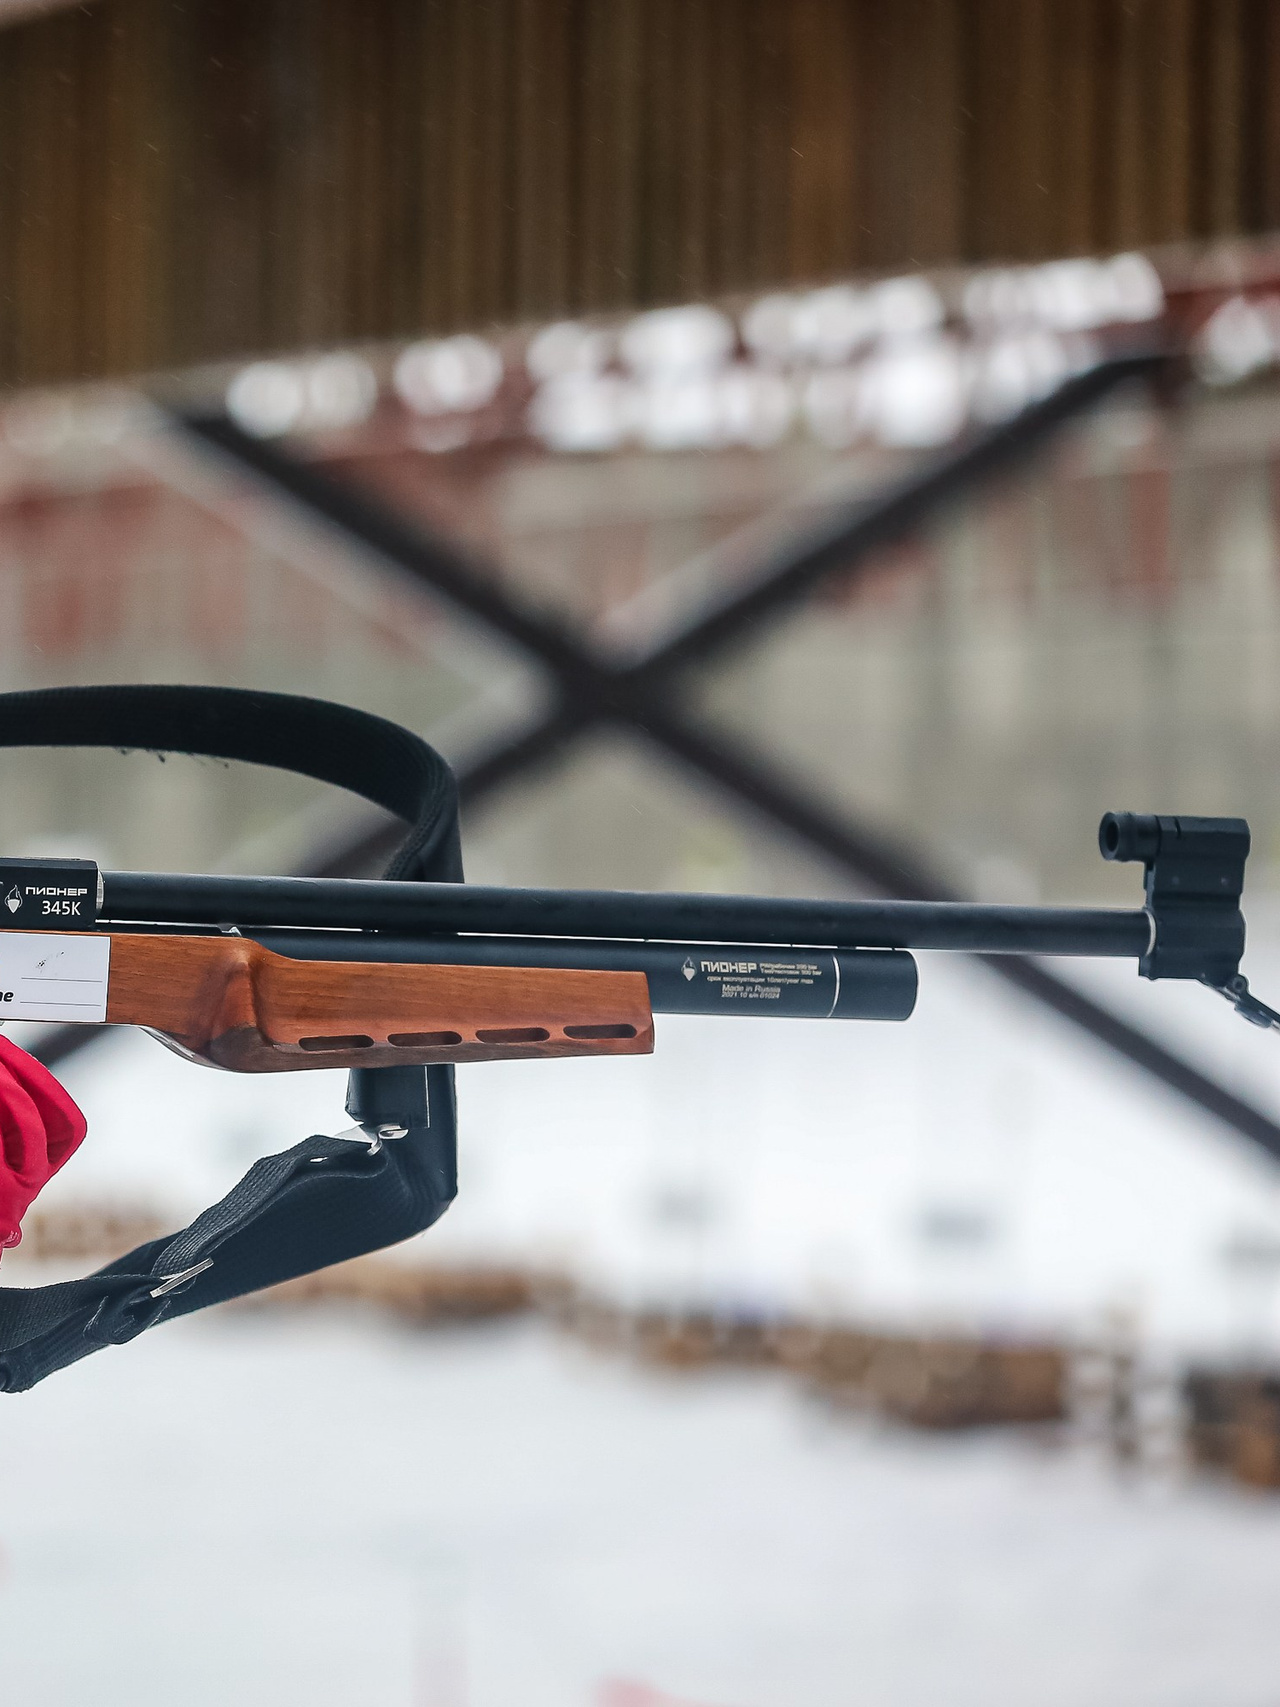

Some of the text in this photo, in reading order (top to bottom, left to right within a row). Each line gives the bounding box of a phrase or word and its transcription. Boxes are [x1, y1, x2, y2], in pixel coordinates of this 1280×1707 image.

[25, 886, 88, 897] ПИОНЕР
[41, 900, 81, 916] 345K
[700, 960, 757, 974] ПИОНЕР
